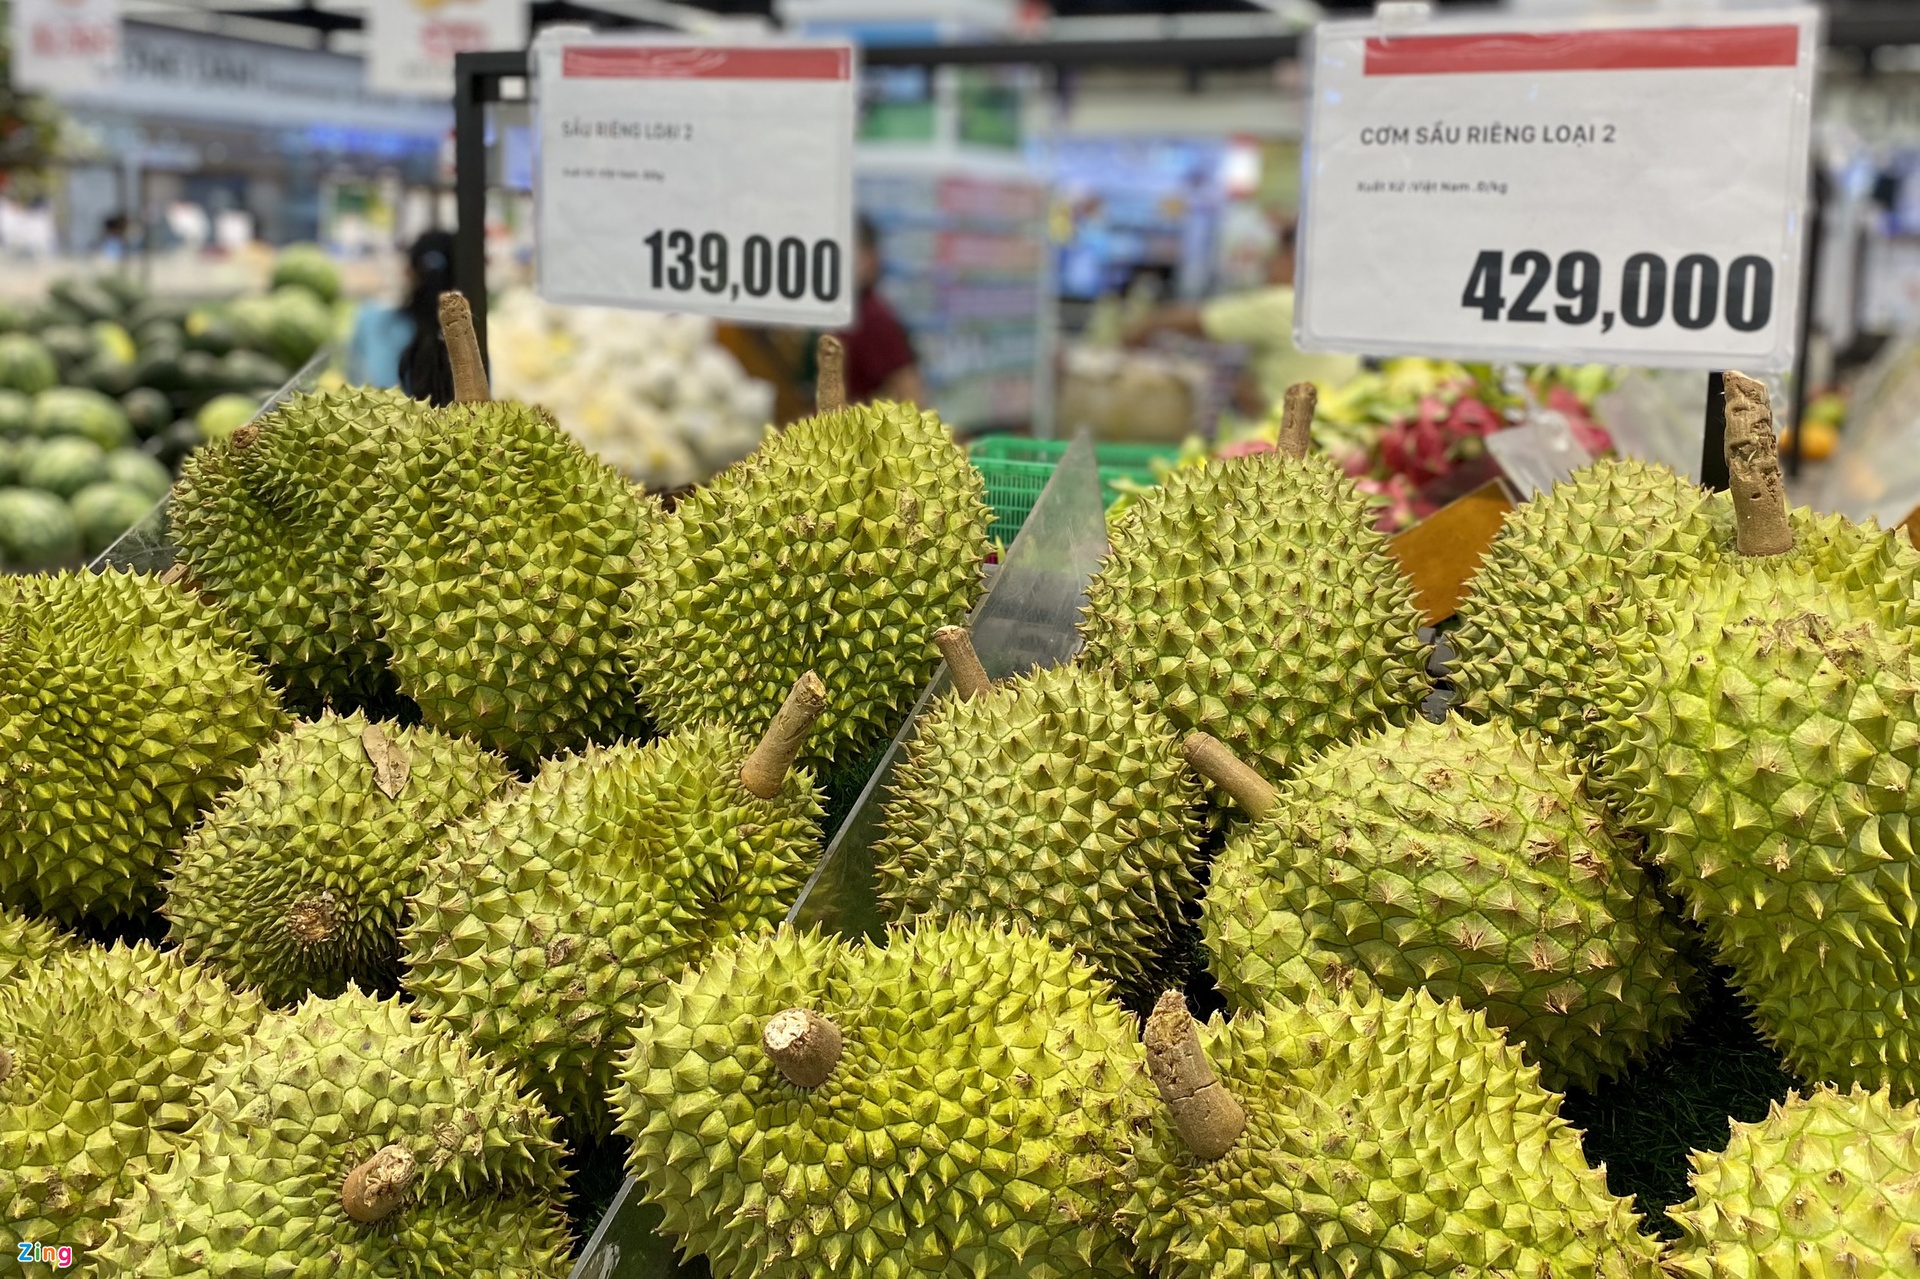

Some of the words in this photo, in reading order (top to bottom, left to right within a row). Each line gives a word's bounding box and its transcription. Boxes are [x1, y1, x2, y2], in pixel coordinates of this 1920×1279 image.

[683, 122, 694, 140] 2
[1360, 124, 1409, 145] CƠM
[1467, 121, 1536, 144] RIÊNG
[1542, 124, 1595, 148] LOẠI
[1602, 124, 1617, 143] 2
[644, 229, 840, 301] 139,000
[1461, 250, 1773, 333] 429,000
